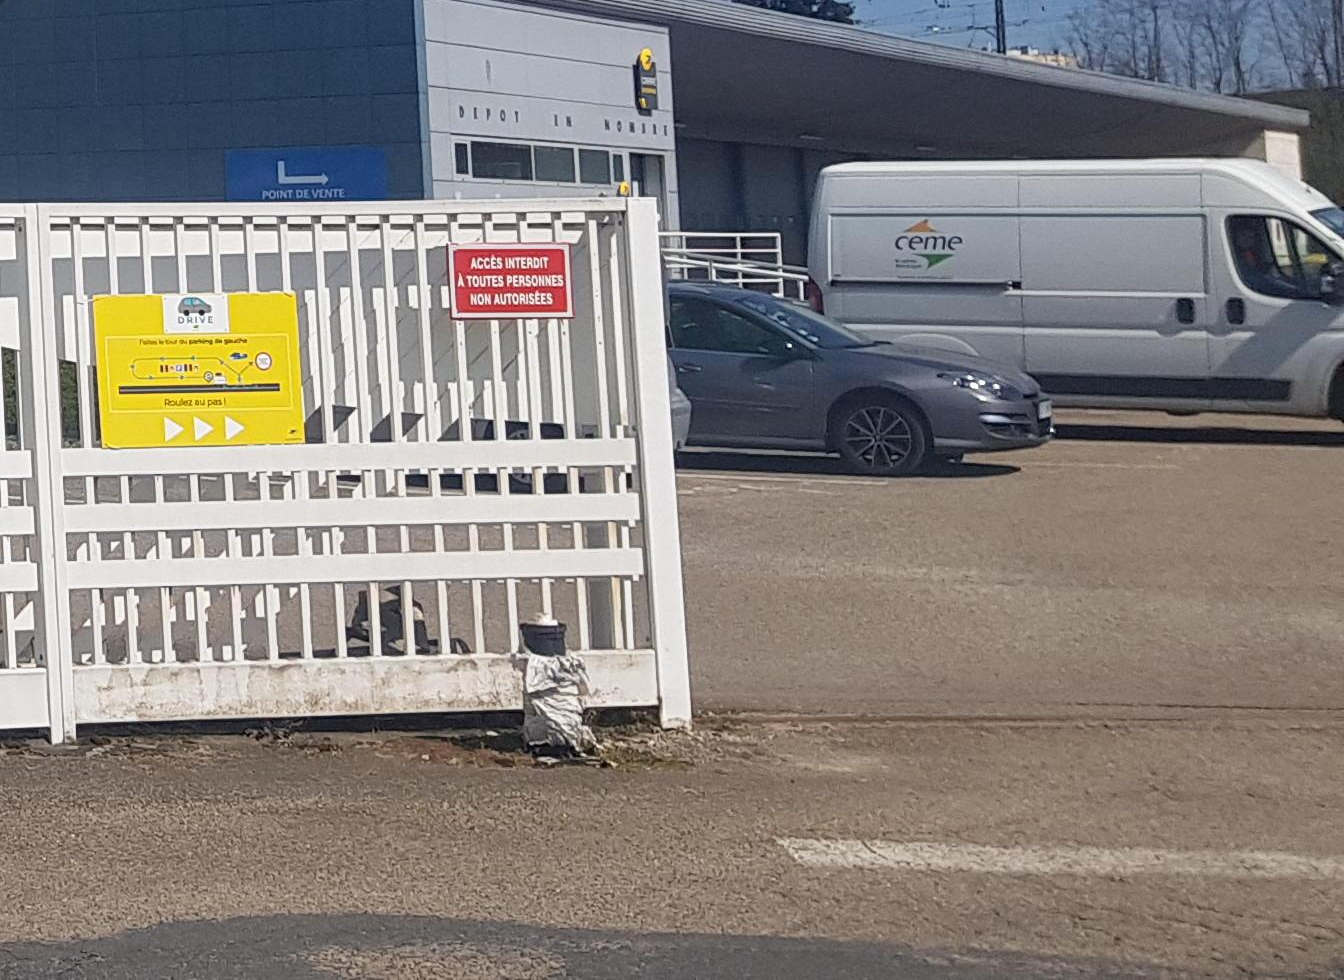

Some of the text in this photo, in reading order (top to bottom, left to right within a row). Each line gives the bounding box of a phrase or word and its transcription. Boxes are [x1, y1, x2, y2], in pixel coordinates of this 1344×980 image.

[459, 106, 519, 123] DEPOT
[262, 188, 345, 200] POINT DE VENTE
[894, 235, 963, 251] ceme
[471, 255, 549, 269] ACCÈS INTERDIT
[466, 275, 504, 287] TOUTES
[507, 274, 564, 287] PERSONNES
[470, 290, 553, 306] NON AUTORISÉES
[178, 316, 214, 324] DRIVE
[164, 398, 193, 407] Roulez
[207, 398, 222, 407] pas
